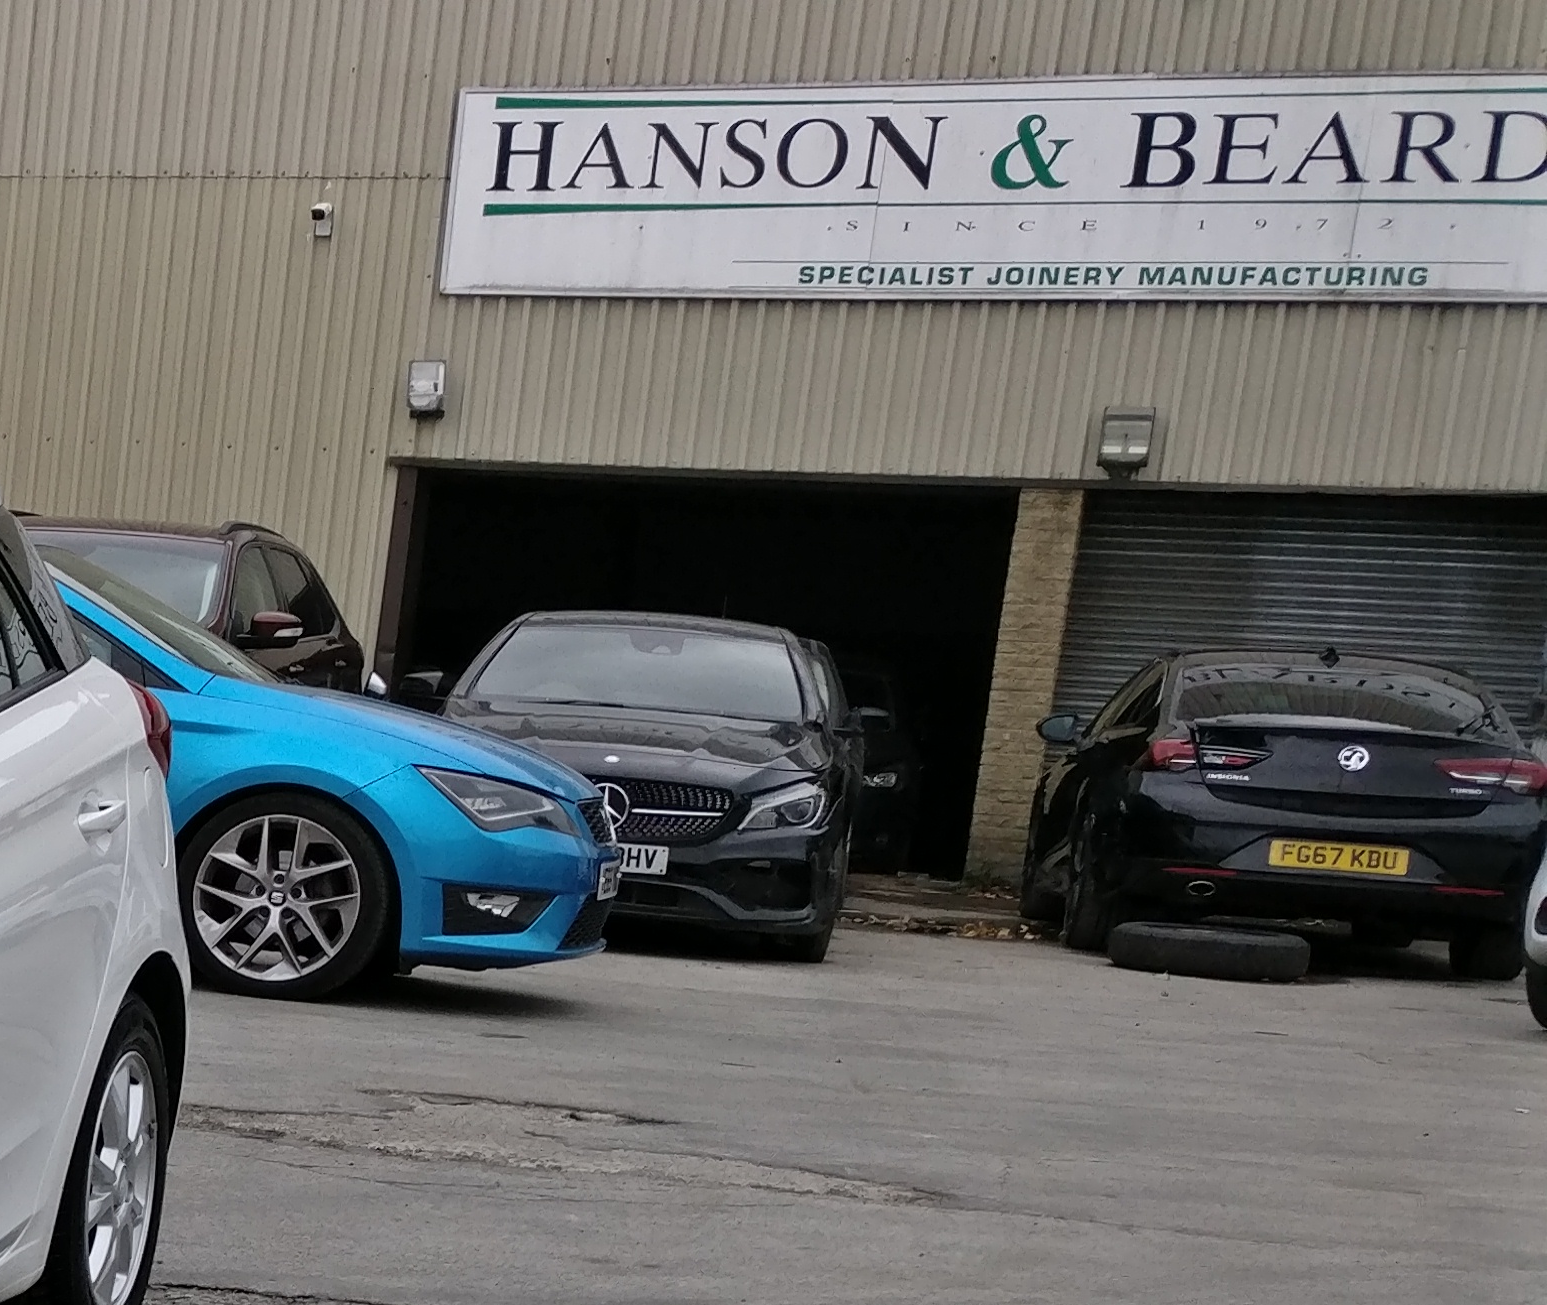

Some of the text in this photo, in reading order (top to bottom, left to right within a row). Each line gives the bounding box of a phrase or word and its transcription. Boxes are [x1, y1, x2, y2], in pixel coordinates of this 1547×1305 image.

[485, 115, 949, 193] HANSON
[989, 113, 1075, 190] &
[797, 265, 1430, 286] SPECIALIST JOINERY MANUFACTURING
[1280, 843, 1398, 870] FG67 KBU
